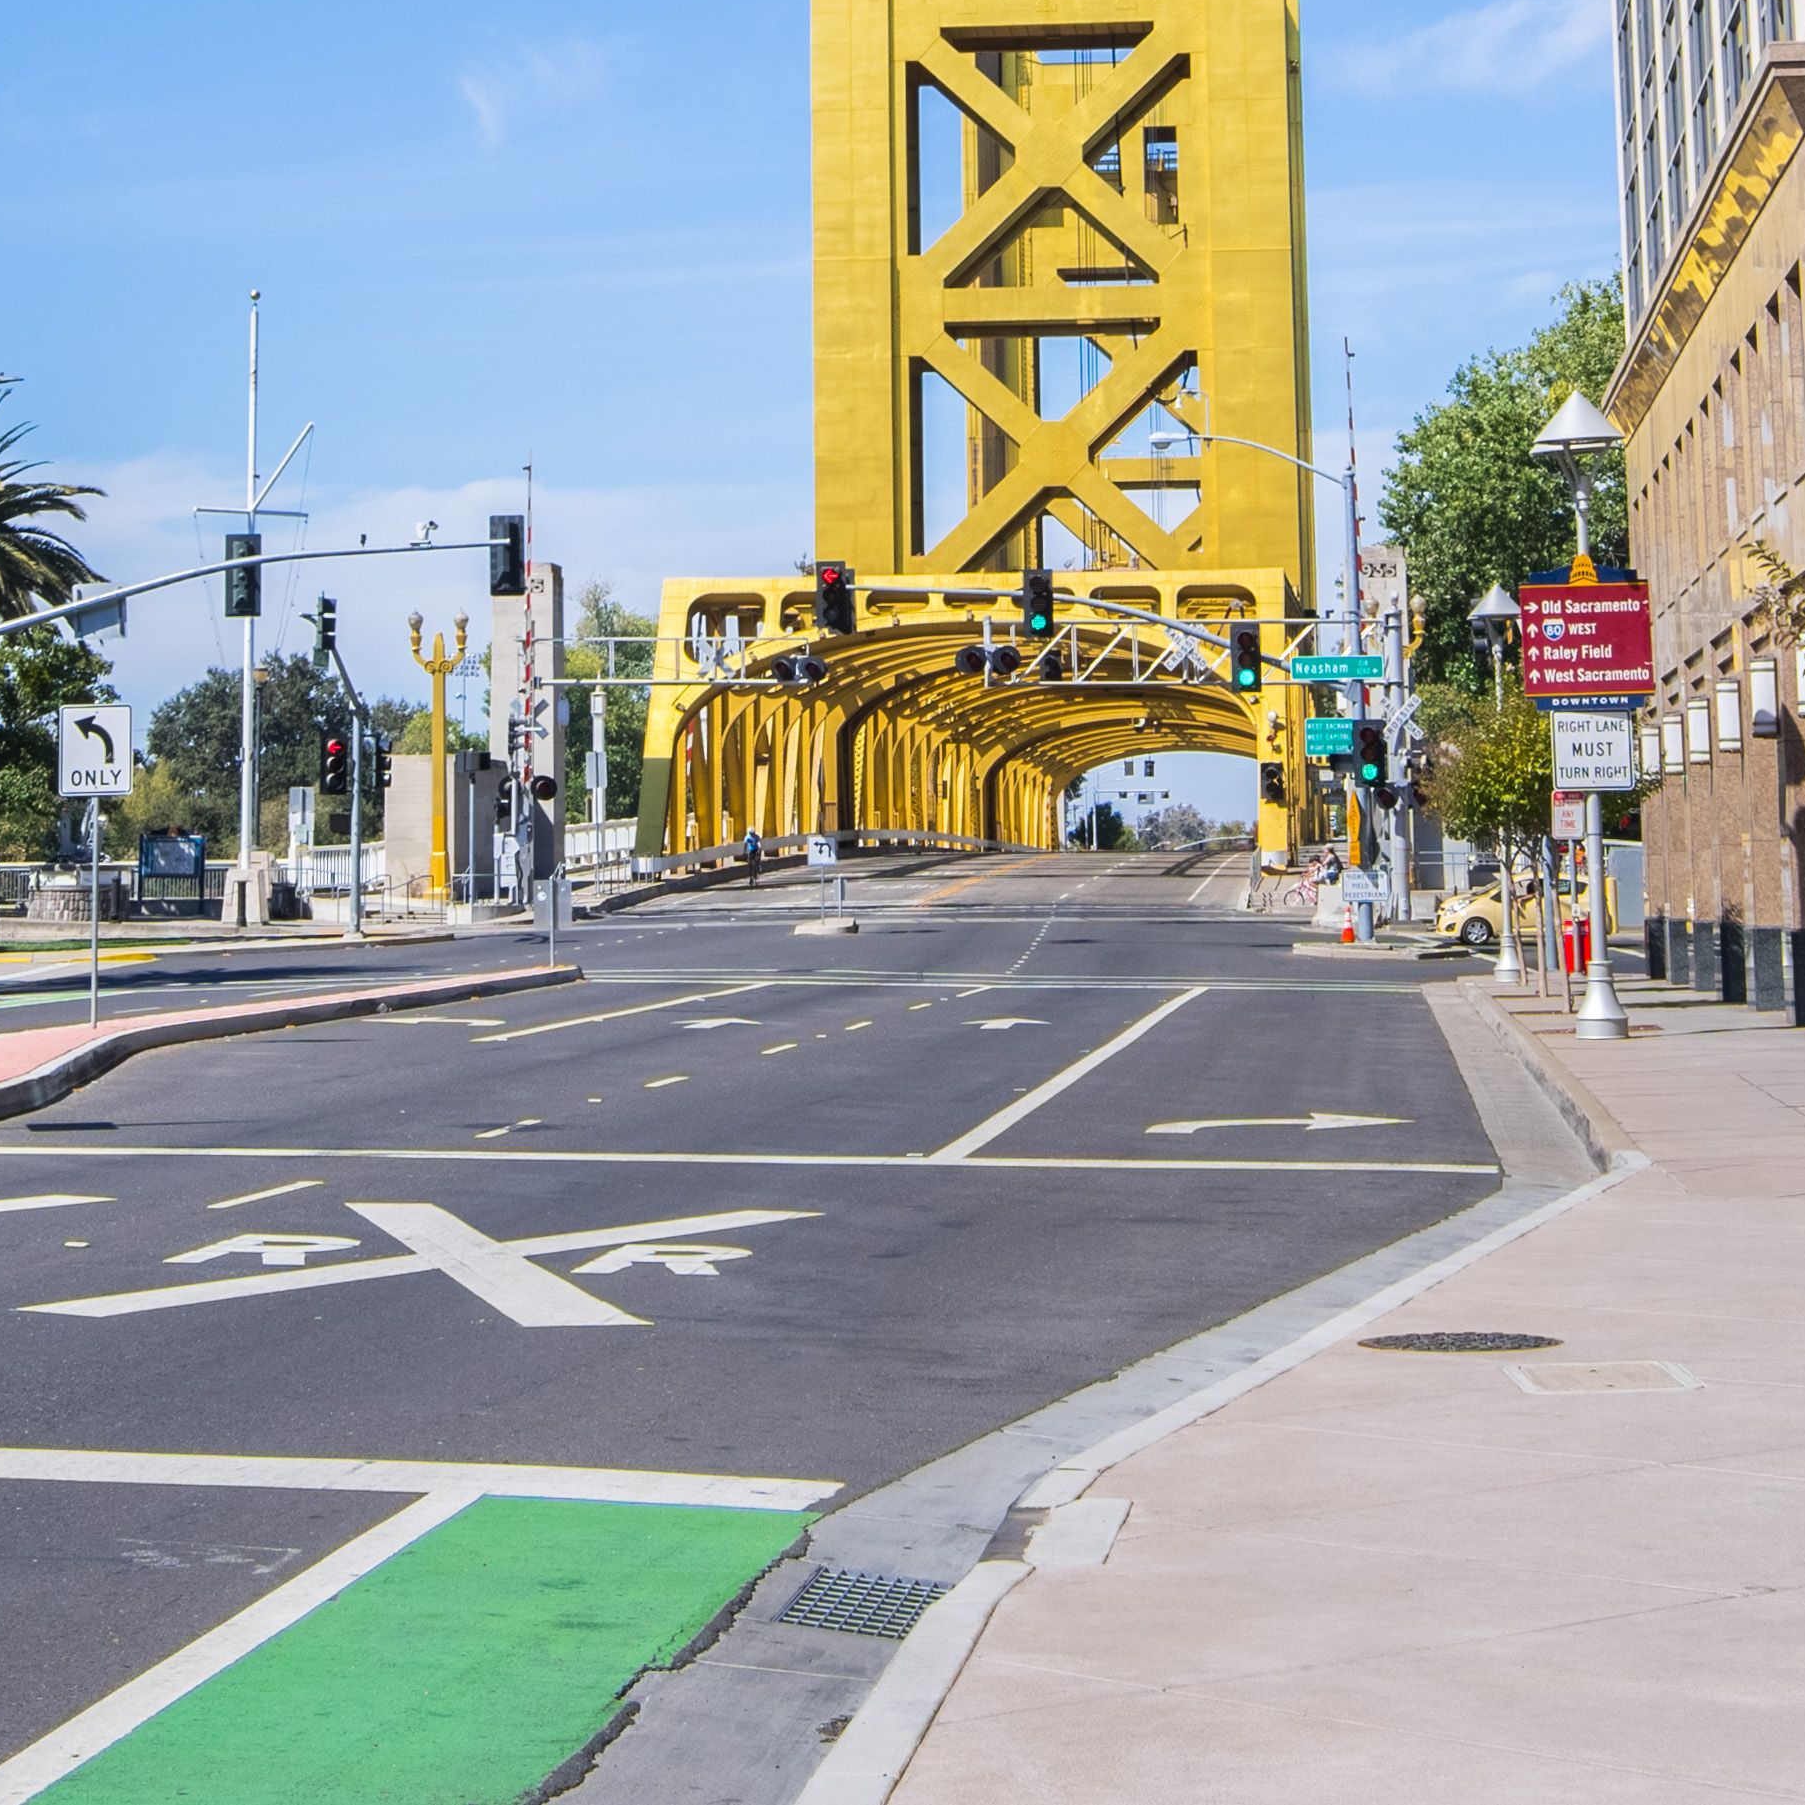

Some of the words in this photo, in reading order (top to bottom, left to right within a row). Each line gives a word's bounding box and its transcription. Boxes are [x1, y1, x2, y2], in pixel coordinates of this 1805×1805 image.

[1541, 600, 1562, 614] Old
[1565, 598, 1640, 613] Sacramento
[1546, 625, 1562, 636] 80
[1568, 623, 1596, 635] WEST
[1543, 646, 1578, 662] Raley
[1581, 644, 1612, 659] Field
[1296, 663, 1348, 674] Neasham
[1544, 668, 1574, 683] West
[1577, 667, 1649, 682] Sacramento
[1552, 696, 1629, 707] DOWNTOWN
[1557, 721, 1591, 733] RIGHT
[1596, 720, 1626, 732] LANE
[1572, 742, 1613, 756] MUST
[71, 769, 122, 787] ONLY
[1559, 767, 1589, 779] TURN
[1594, 766, 1628, 778] RIGHT
